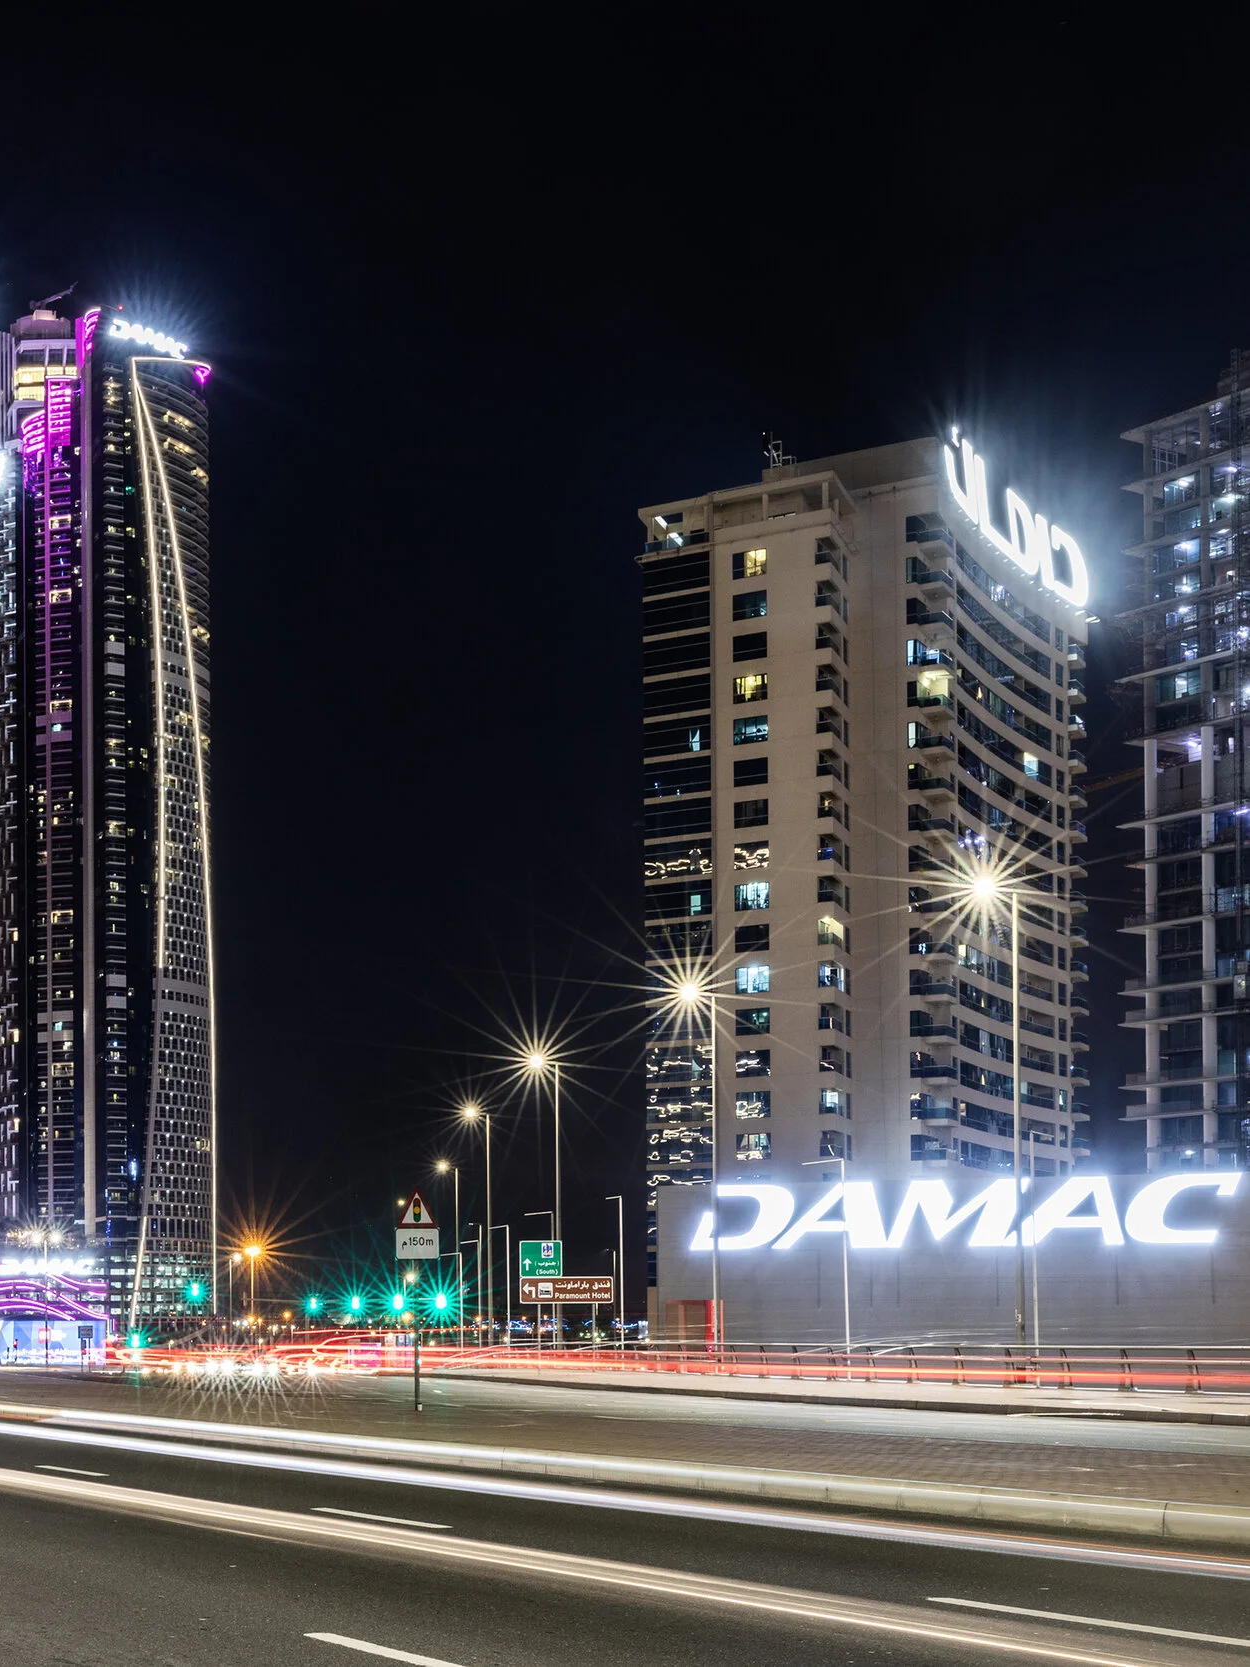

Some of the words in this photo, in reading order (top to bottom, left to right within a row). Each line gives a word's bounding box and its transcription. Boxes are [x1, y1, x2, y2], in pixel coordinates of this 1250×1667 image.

[943, 426, 1089, 606] داماك
[688, 1171, 1243, 1252] DAMAC
[535, 1268, 559, 1276] (South)
[592, 1280, 611, 1290] فندق
[554, 1292, 591, 1300] Paramount
[591, 1292, 611, 1300] Hotel
